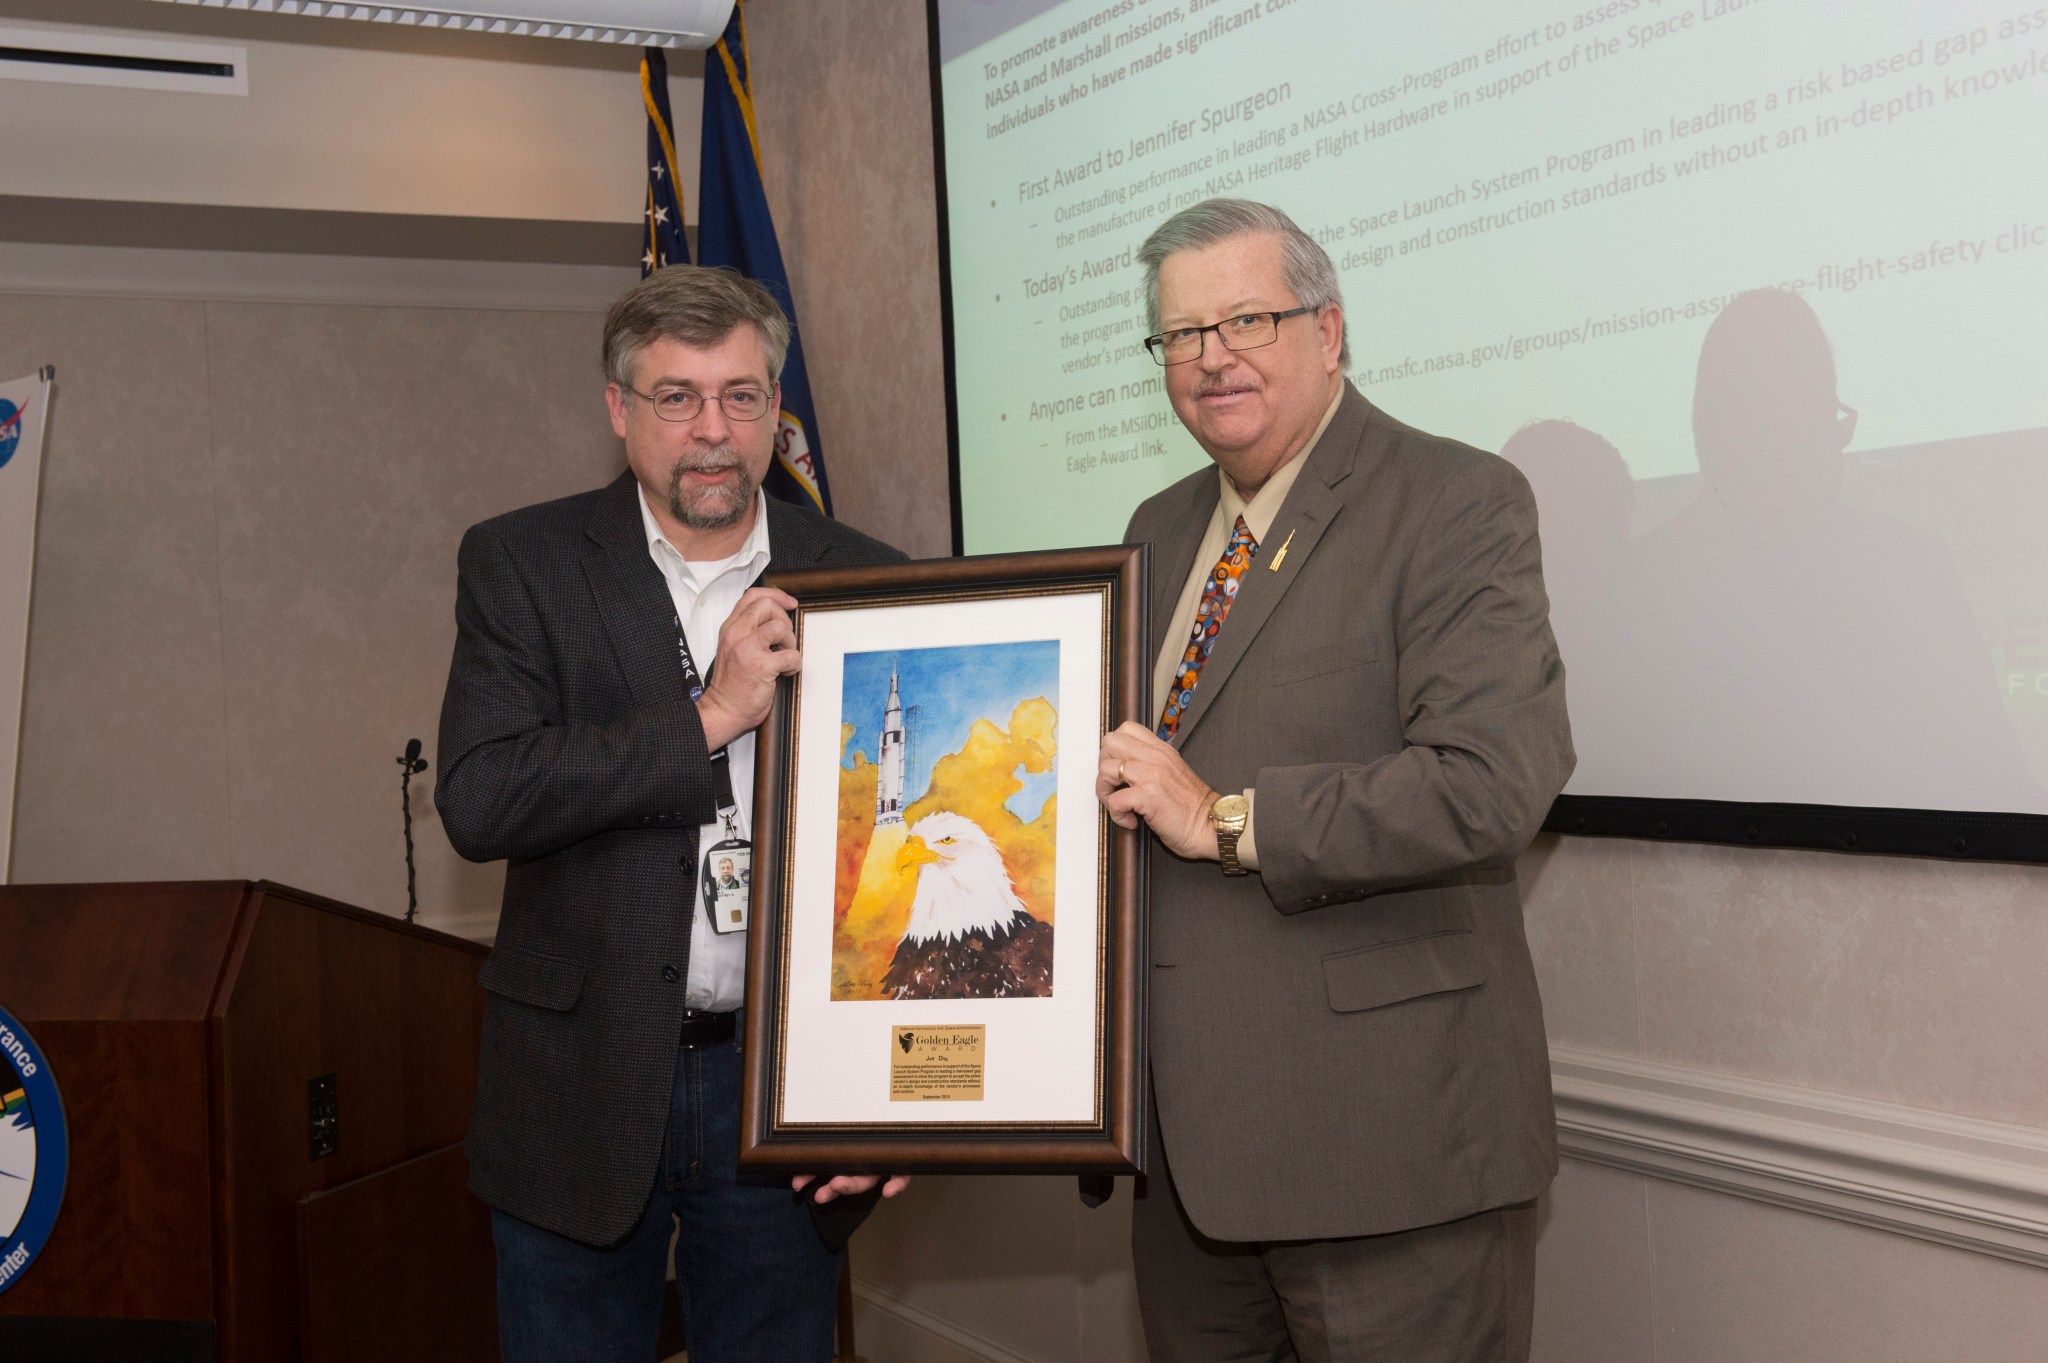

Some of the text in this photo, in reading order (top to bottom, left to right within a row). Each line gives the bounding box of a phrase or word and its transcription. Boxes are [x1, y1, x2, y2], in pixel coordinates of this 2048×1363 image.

[983, 1, 1134, 81] To promote awareness
[985, 80, 1020, 110] NASA
[1023, 68, 1047, 92] and
[1051, 34, 1111, 80] Marshall
[1115, 6, 1185, 49] missions,
[986, 95, 1055, 140] individuals
[1058, 82, 1088, 107] who
[1092, 64, 1126, 93] have
[1130, 43, 1172, 75] made
[1177, 4, 1261, 55] significant
[1019, 82, 1291, 203] First Award to Jennifer Spurgeon
[1054, 0, 1640, 223] Outstanding performance in leading a NASA Cross-Program effort to assess
[1056, 228, 1075, 249] the
[1078, 203, 1155, 242] manufacture
[1158, 193, 1173, 214] of
[1175, 169, 1245, 208] non-NASA
[1248, 147, 1311, 183] Heritage
[1315, 129, 1359, 158] Flight
[1363, 100, 1448, 142] Hardware
[1453, 90, 1470, 110] in
[1476, 59, 1552, 102] support
[1558, 44, 1580, 73] of
[1585, 37, 1621, 63] the
[1627, 10, 1694, 49] Space
[1318, 224, 1345, 246] the
[1350, 210, 1398, 239] Space
[1403, 185, 1466, 221] Launch
[1471, 165, 1540, 202] System
[1546, 137, 1635, 177] Program
[1643, 127, 1662, 148] in
[1670, 99, 1757, 140] leading
[1764, 92, 1777, 111] a
[1787, 70, 1833, 105] risk
[1842, 38, 1924, 88] based
[1934, 28, 1988, 66] gap
[1341, 242, 1394, 272] design
[1399, 228, 1431, 255] and
[1436, 195, 1556, 245] construction
[1562, 162, 1667, 210] standards
[1674, 133, 1768, 178] without
[1776, 125, 1807, 149] an
[1816, 83, 1934, 138] in-depth
[1081, 244, 1131, 281] Award
[1059, 287, 1131, 322] Outstanding
[1060, 331, 1080, 349] the
[1083, 318, 1133, 342] program
[1029, 395, 1084, 423] Anyone
[1088, 388, 1116, 408] can
[1065, 427, 1095, 447] From
[1098, 423, 1118, 440] the
[1067, 438, 1168, 474] Eagle Award link.
[916, 1035, 978, 1045] Golden Eagle
